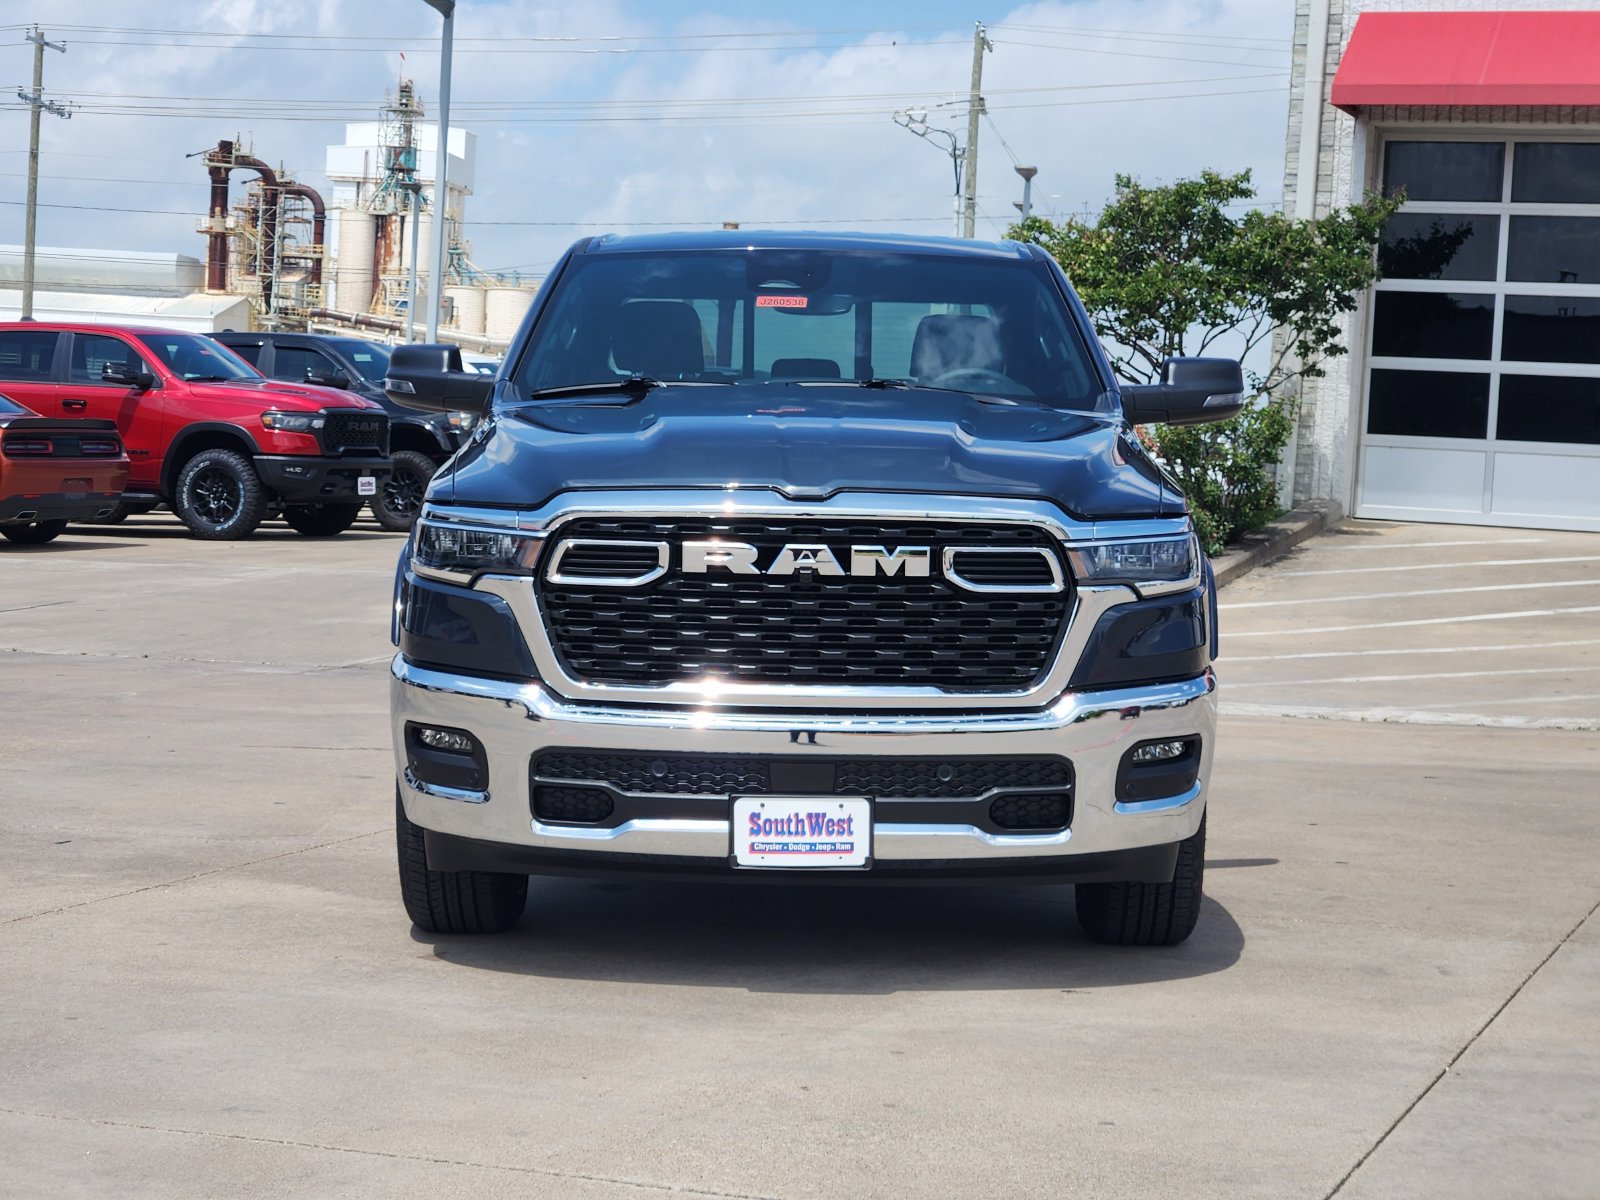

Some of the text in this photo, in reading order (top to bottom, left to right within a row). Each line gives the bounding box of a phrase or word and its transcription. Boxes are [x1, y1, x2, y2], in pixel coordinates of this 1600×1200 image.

[759, 298, 804, 306] J260538
[347, 421, 379, 431] RAM
[681, 541, 931, 577] RAM
[753, 842, 783, 852] Chrysler
[788, 842, 811, 852] Dodge
[835, 842, 851, 851] Ram
